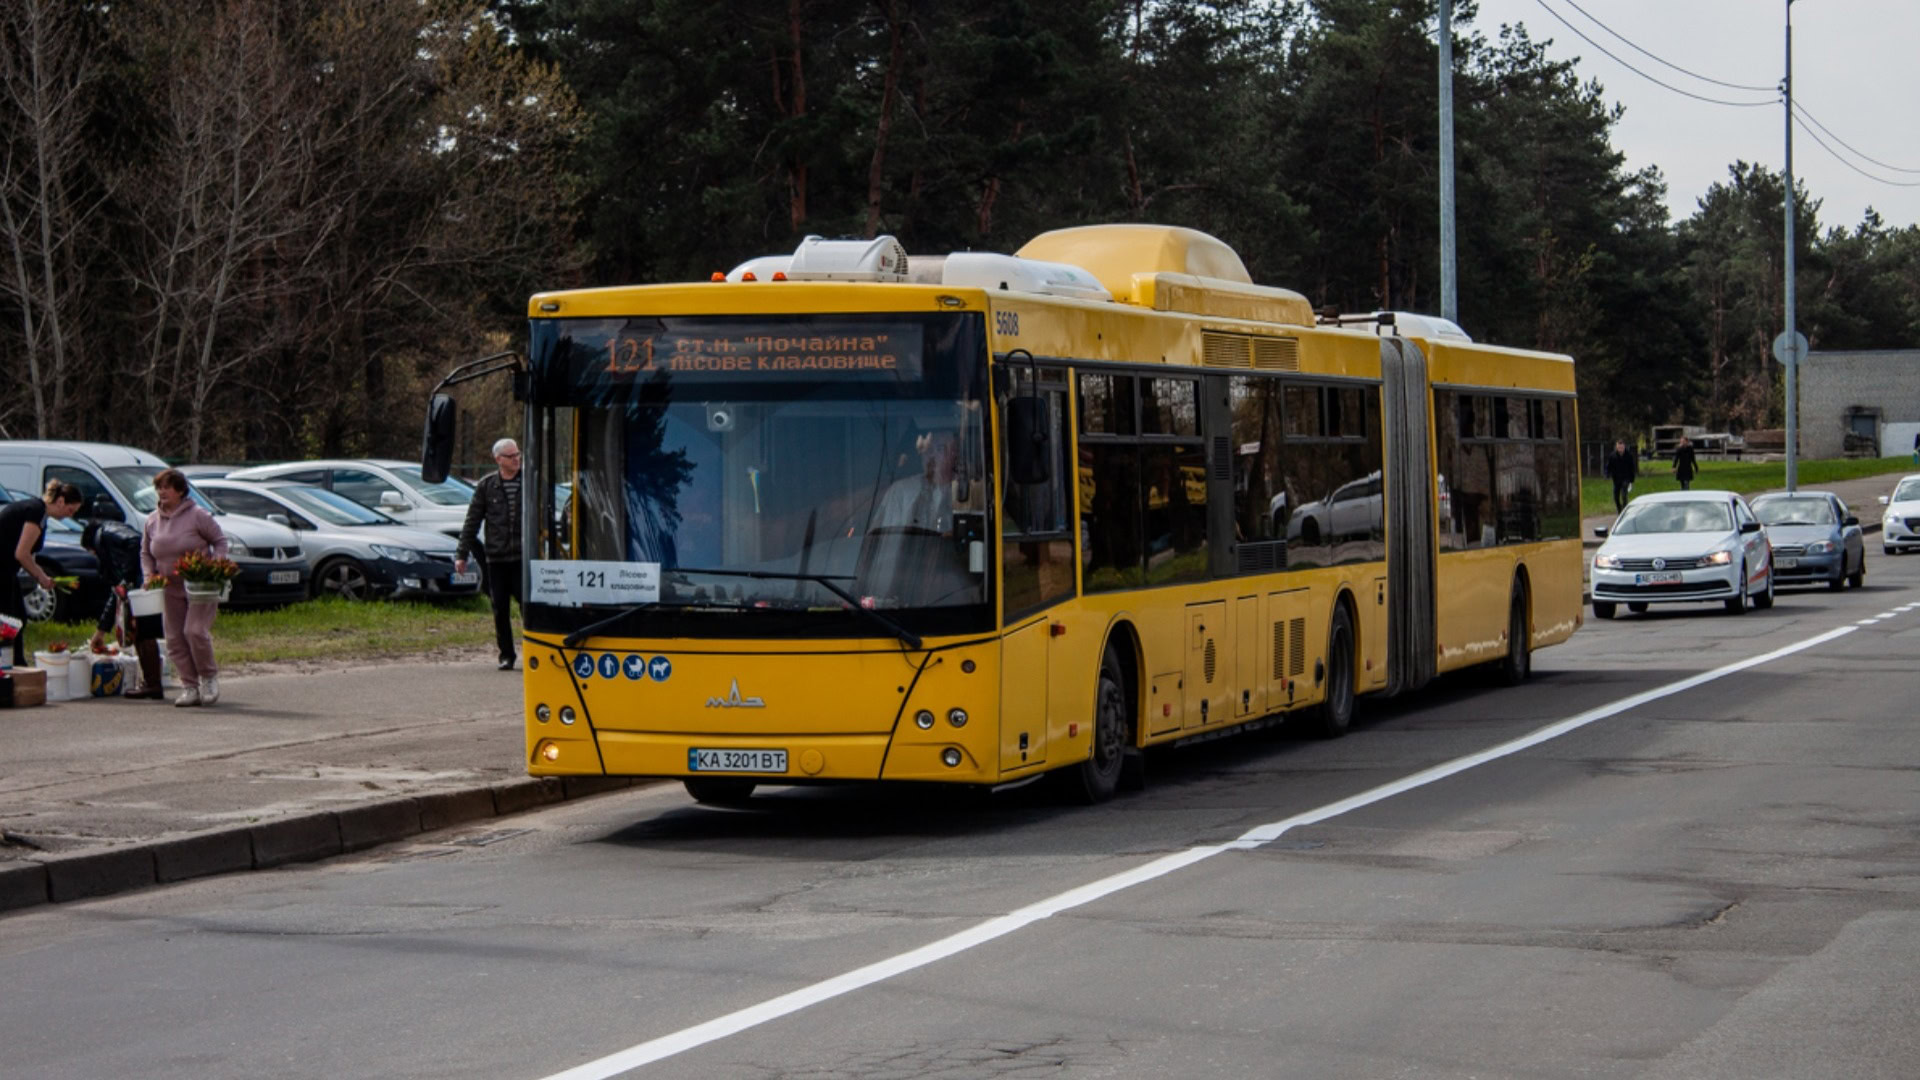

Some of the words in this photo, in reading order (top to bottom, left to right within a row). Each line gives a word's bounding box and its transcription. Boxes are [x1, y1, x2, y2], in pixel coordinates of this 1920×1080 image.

[996, 311, 1019, 336] 5608
[744, 335, 889, 352] "Почайна"
[605, 338, 656, 371] 121
[757, 354, 897, 370] кладовище
[577, 571, 604, 588] 121
[619, 569, 647, 579] Лісове
[610, 583, 656, 592] кладовище
[698, 752, 720, 768] KA
[724, 752, 758, 769] 3201
[761, 753, 784, 769] BT
